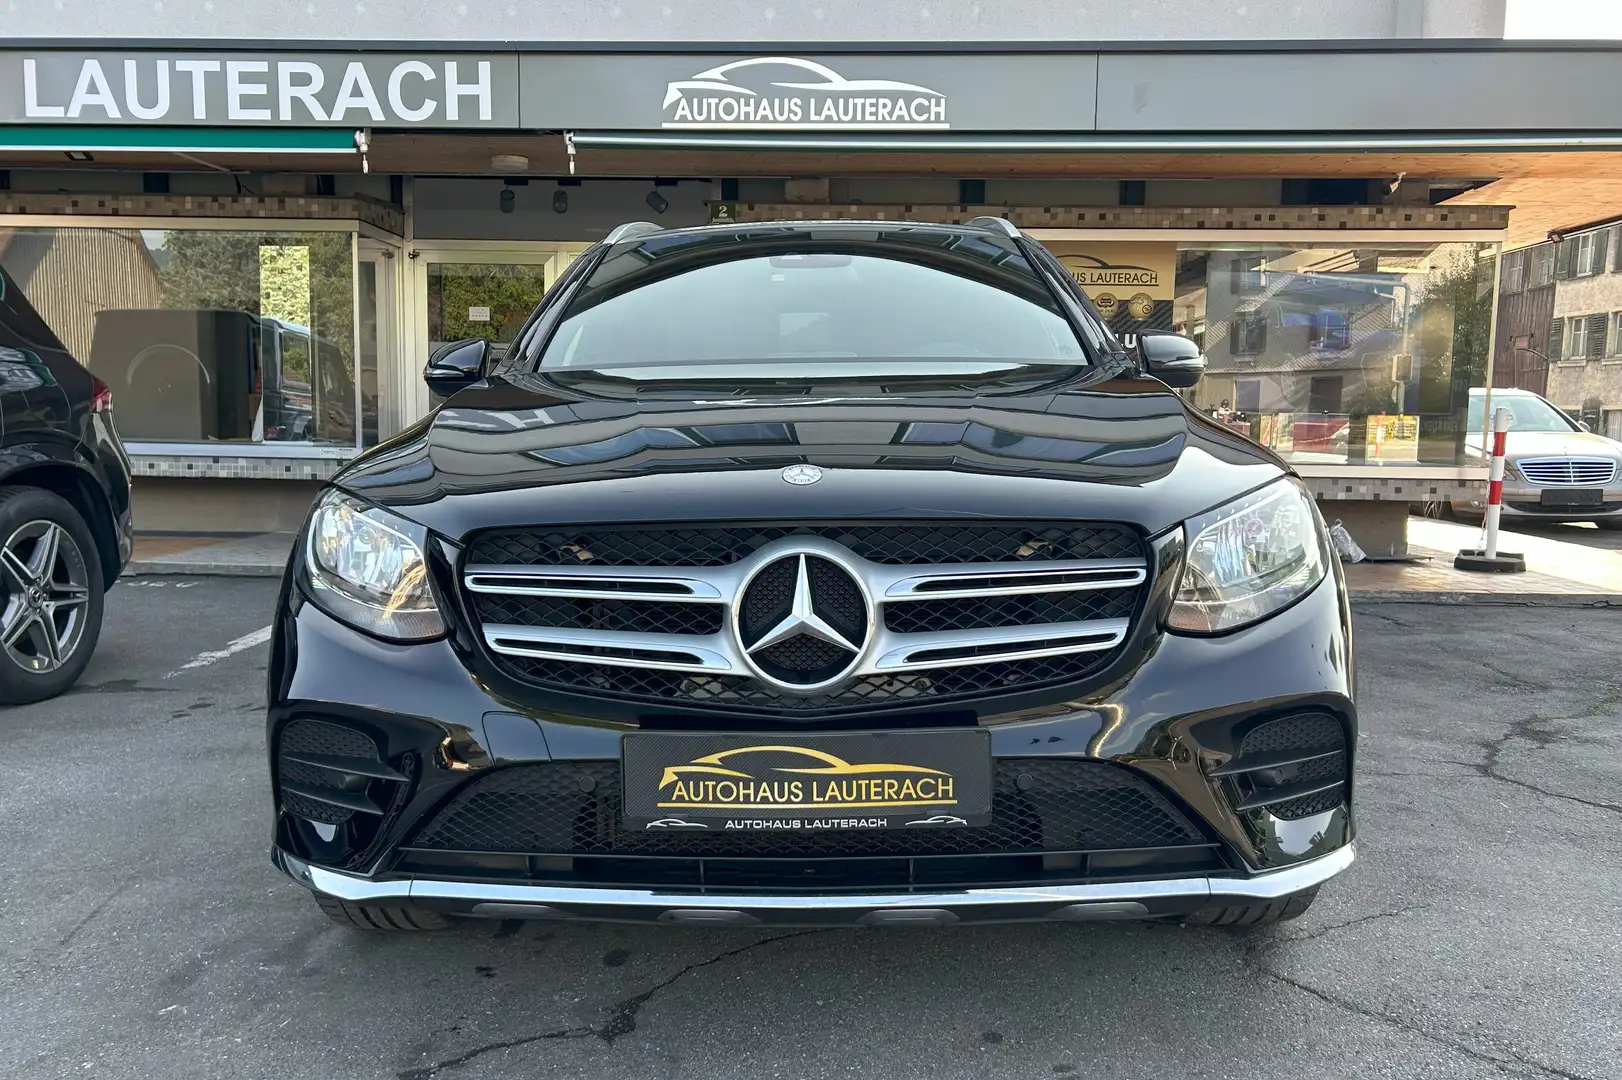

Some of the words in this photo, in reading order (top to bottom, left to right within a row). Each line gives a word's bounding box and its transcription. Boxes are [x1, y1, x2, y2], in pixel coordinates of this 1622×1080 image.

[23, 58, 492, 122] LAUTERACH
[673, 97, 803, 122] AUTOHAUS
[809, 97, 946, 122] LAUTERACH
[718, 205, 728, 217] 2
[1090, 272, 1158, 284] LAUTERACH
[671, 780, 803, 803] AUTOHAUS
[812, 777, 954, 803] LAUTERACH
[725, 819, 801, 829] AUTOHAUS
[805, 818, 888, 829] LAUTERACH
